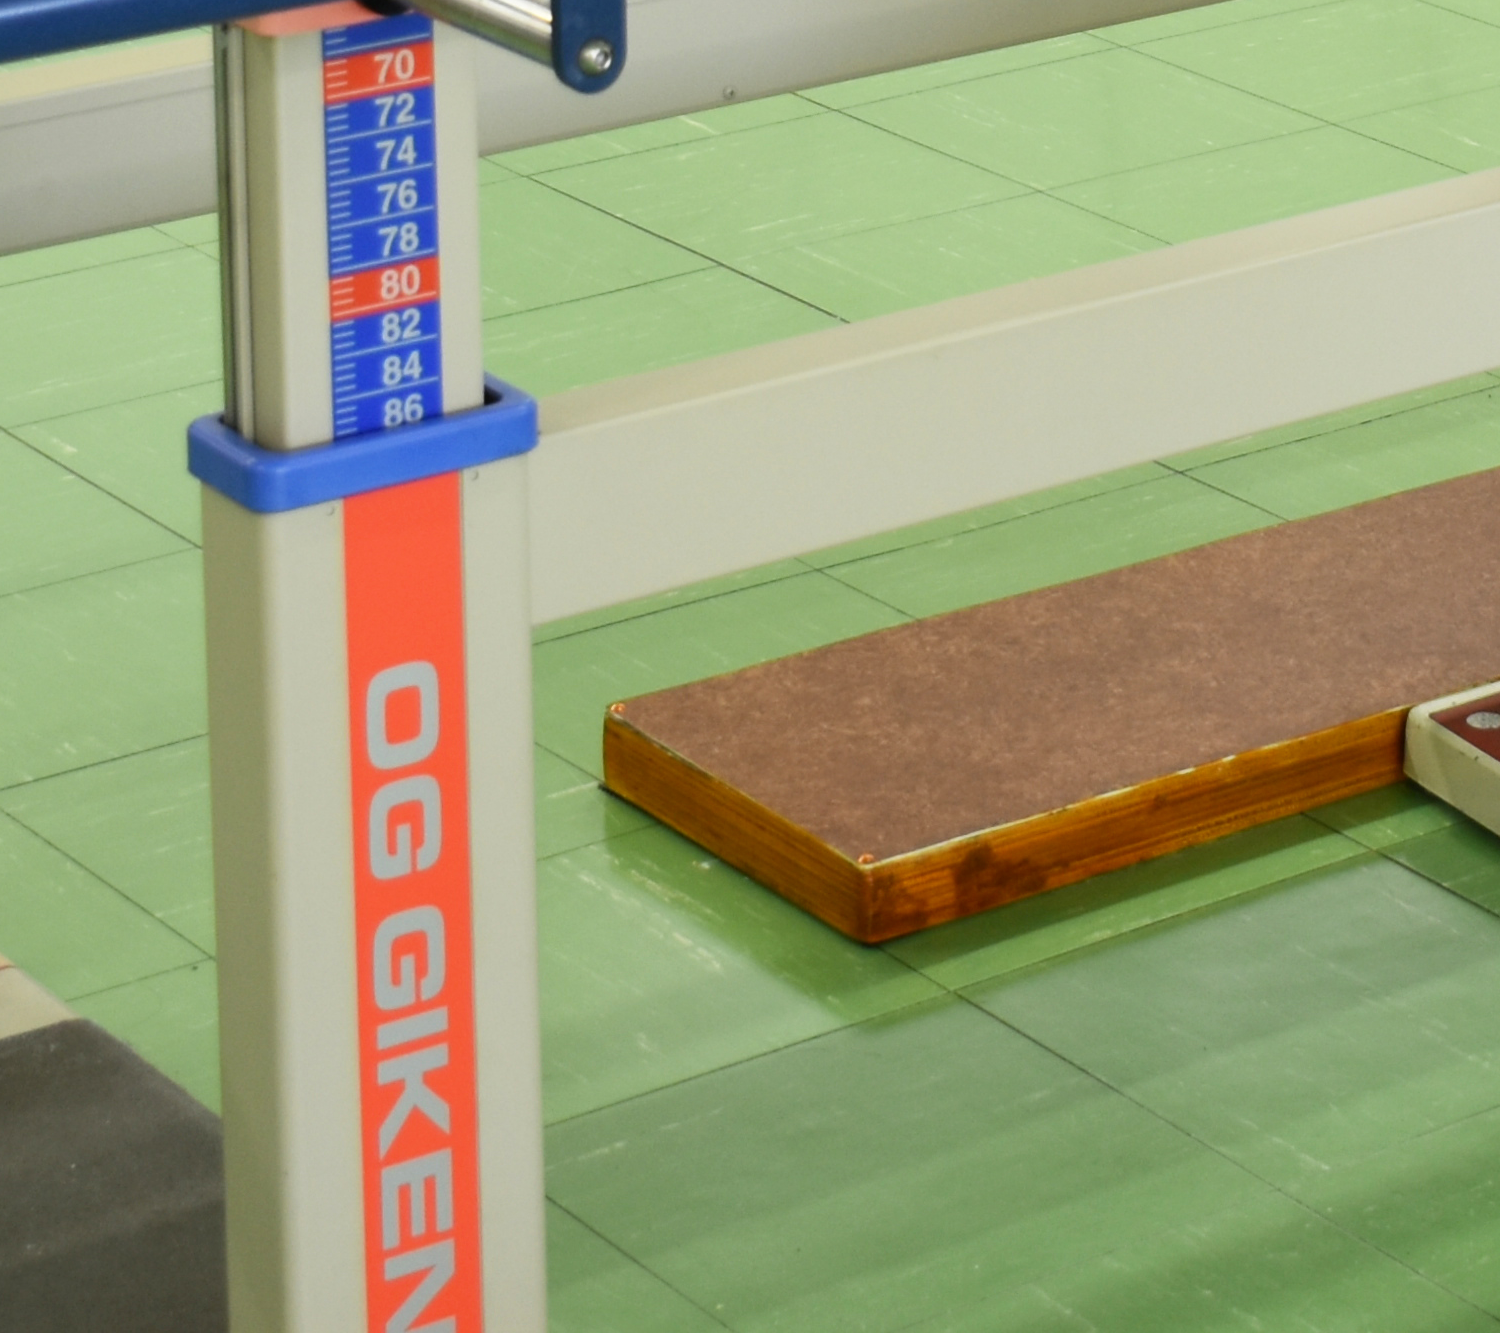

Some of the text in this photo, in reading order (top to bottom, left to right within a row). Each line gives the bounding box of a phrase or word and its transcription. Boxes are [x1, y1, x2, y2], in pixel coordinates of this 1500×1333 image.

[375, 49, 415, 84] 70
[375, 92, 416, 127] 72
[376, 136, 417, 171] 74
[377, 179, 418, 214] 76
[378, 222, 419, 257] 78
[380, 265, 421, 301] 80
[381, 308, 422, 344] 82
[382, 351, 423, 387] 84
[383, 393, 424, 429] 86
[365, 660, 457, 1333] OG GIKEN
